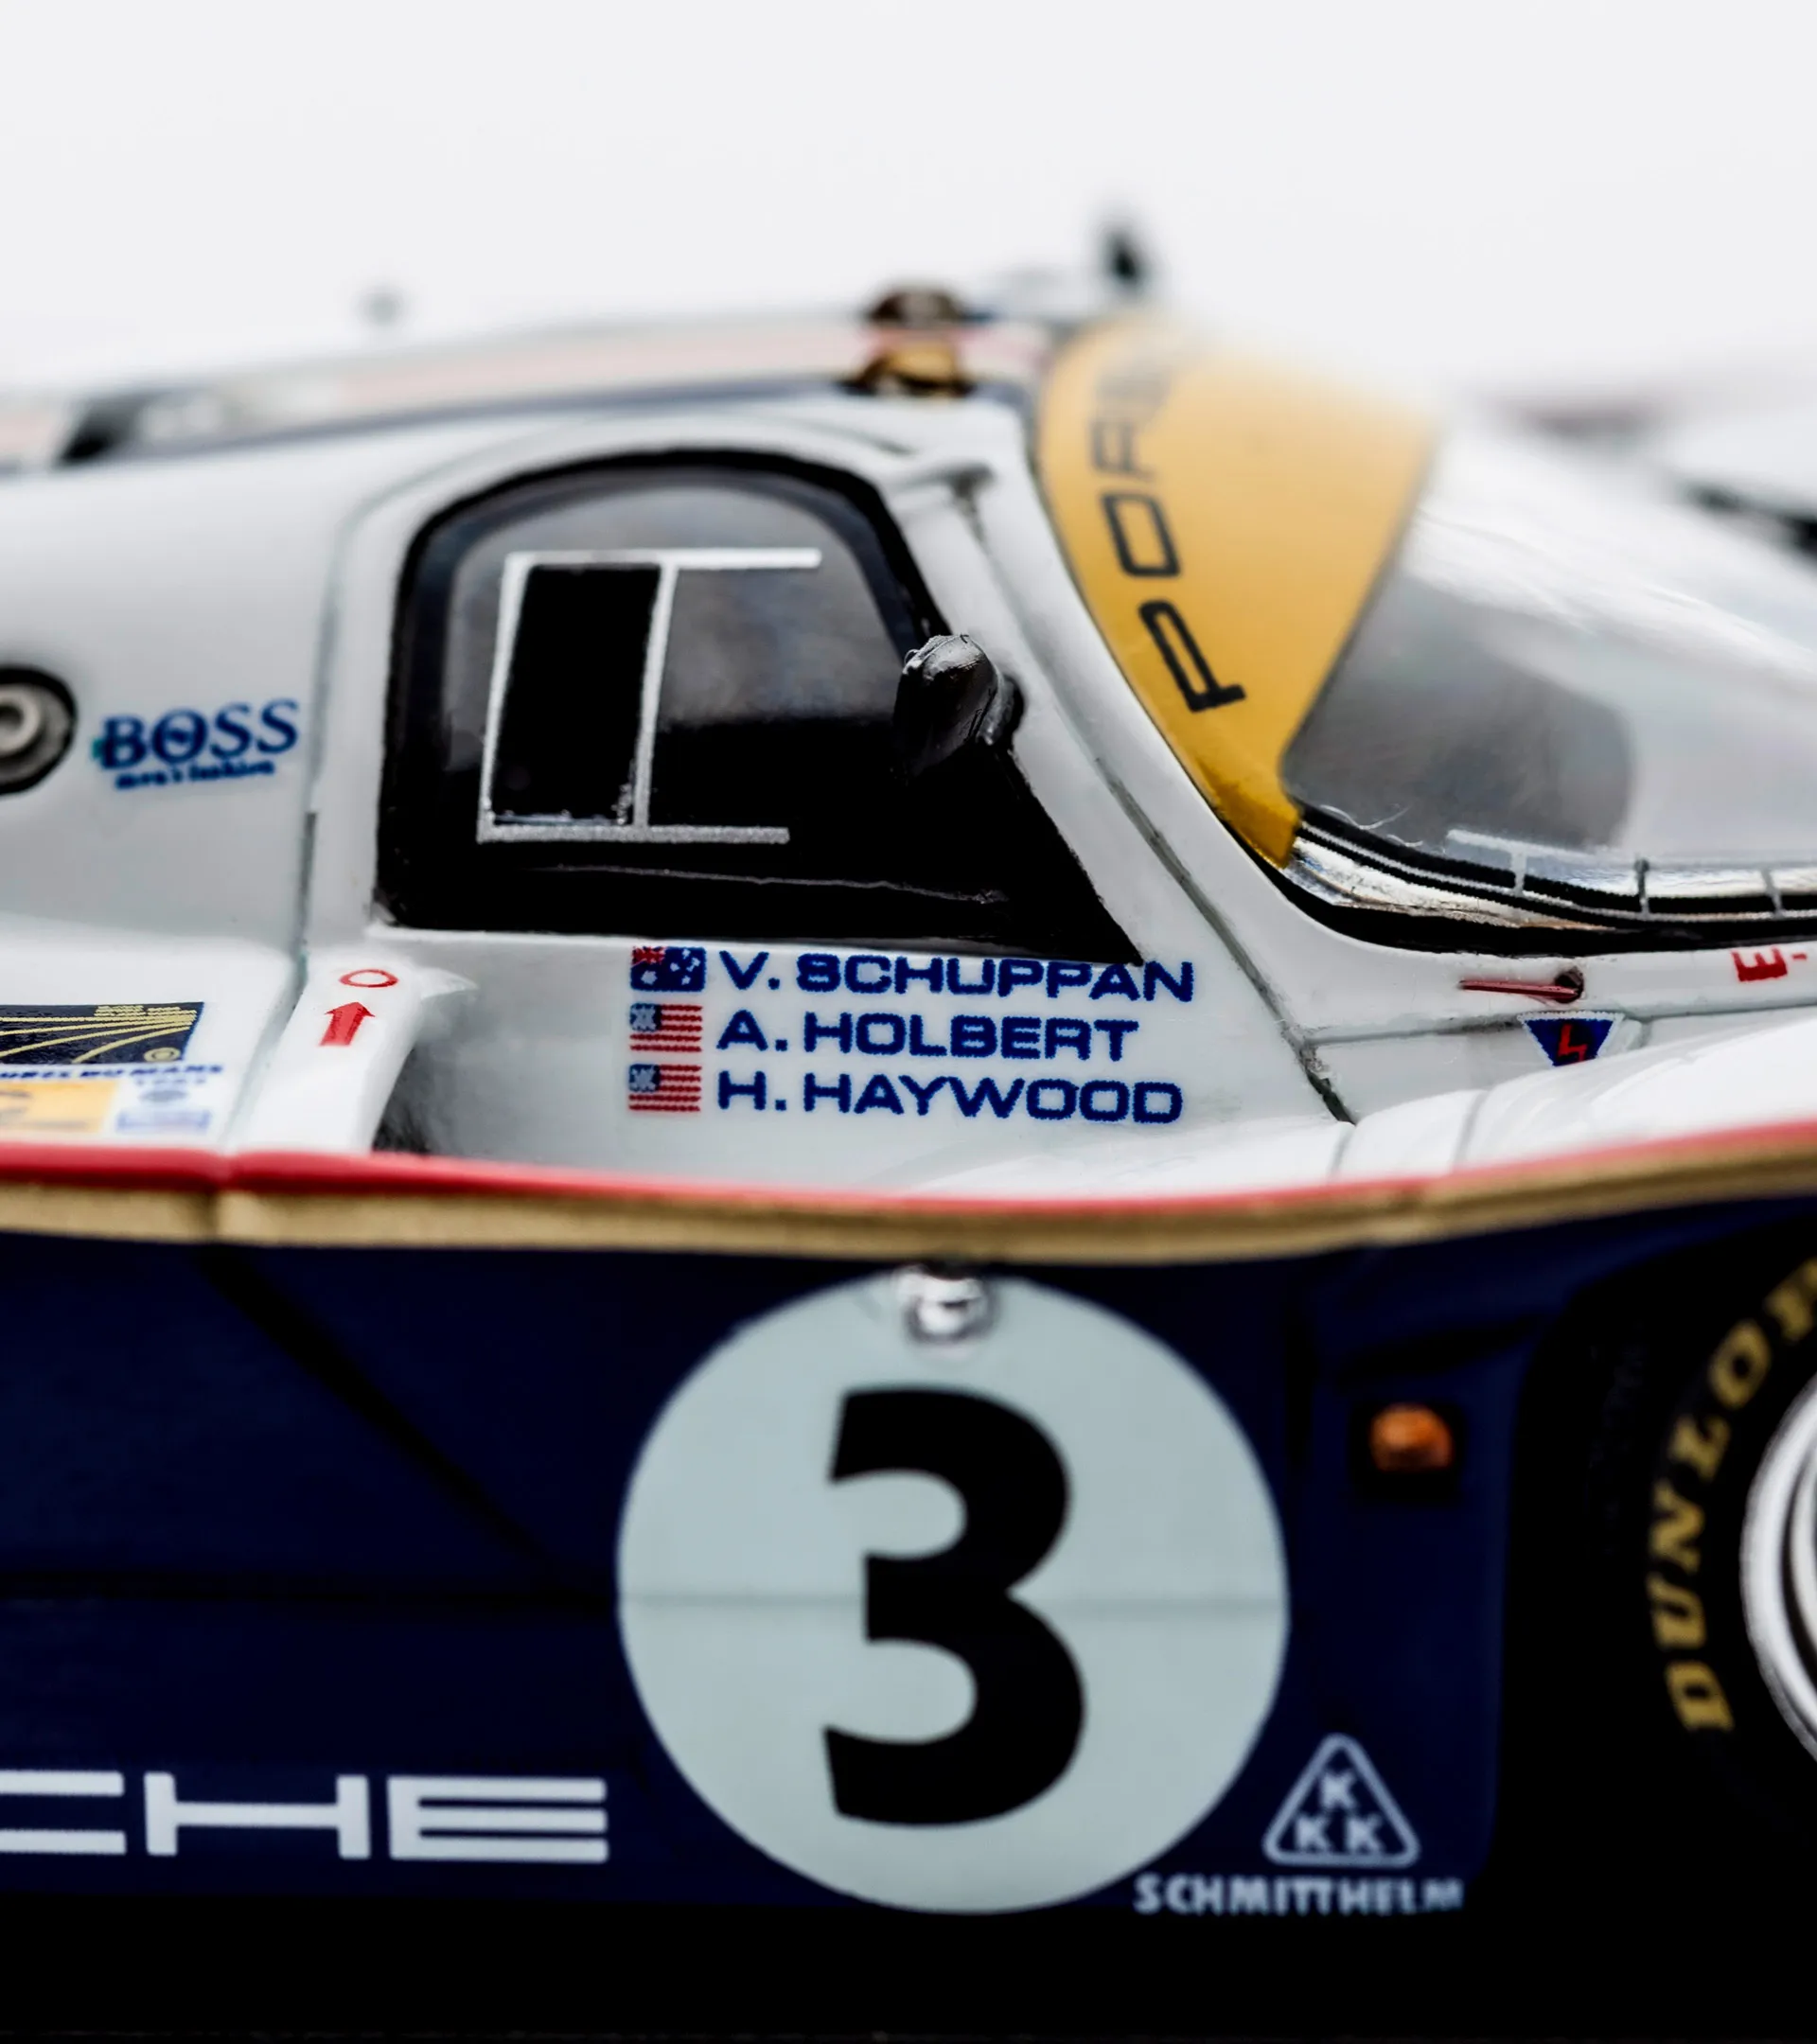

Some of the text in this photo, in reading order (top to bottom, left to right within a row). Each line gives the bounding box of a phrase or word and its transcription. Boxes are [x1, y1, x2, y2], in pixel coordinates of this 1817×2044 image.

[98, 698, 299, 770] BOSS
[719, 950, 1194, 1003] V. SCHUPPAN
[716, 1010, 1139, 1062] A. HOLBERT
[717, 1070, 1183, 1123] H. HAYWOOD
[823, 1385, 1087, 1828] 3
